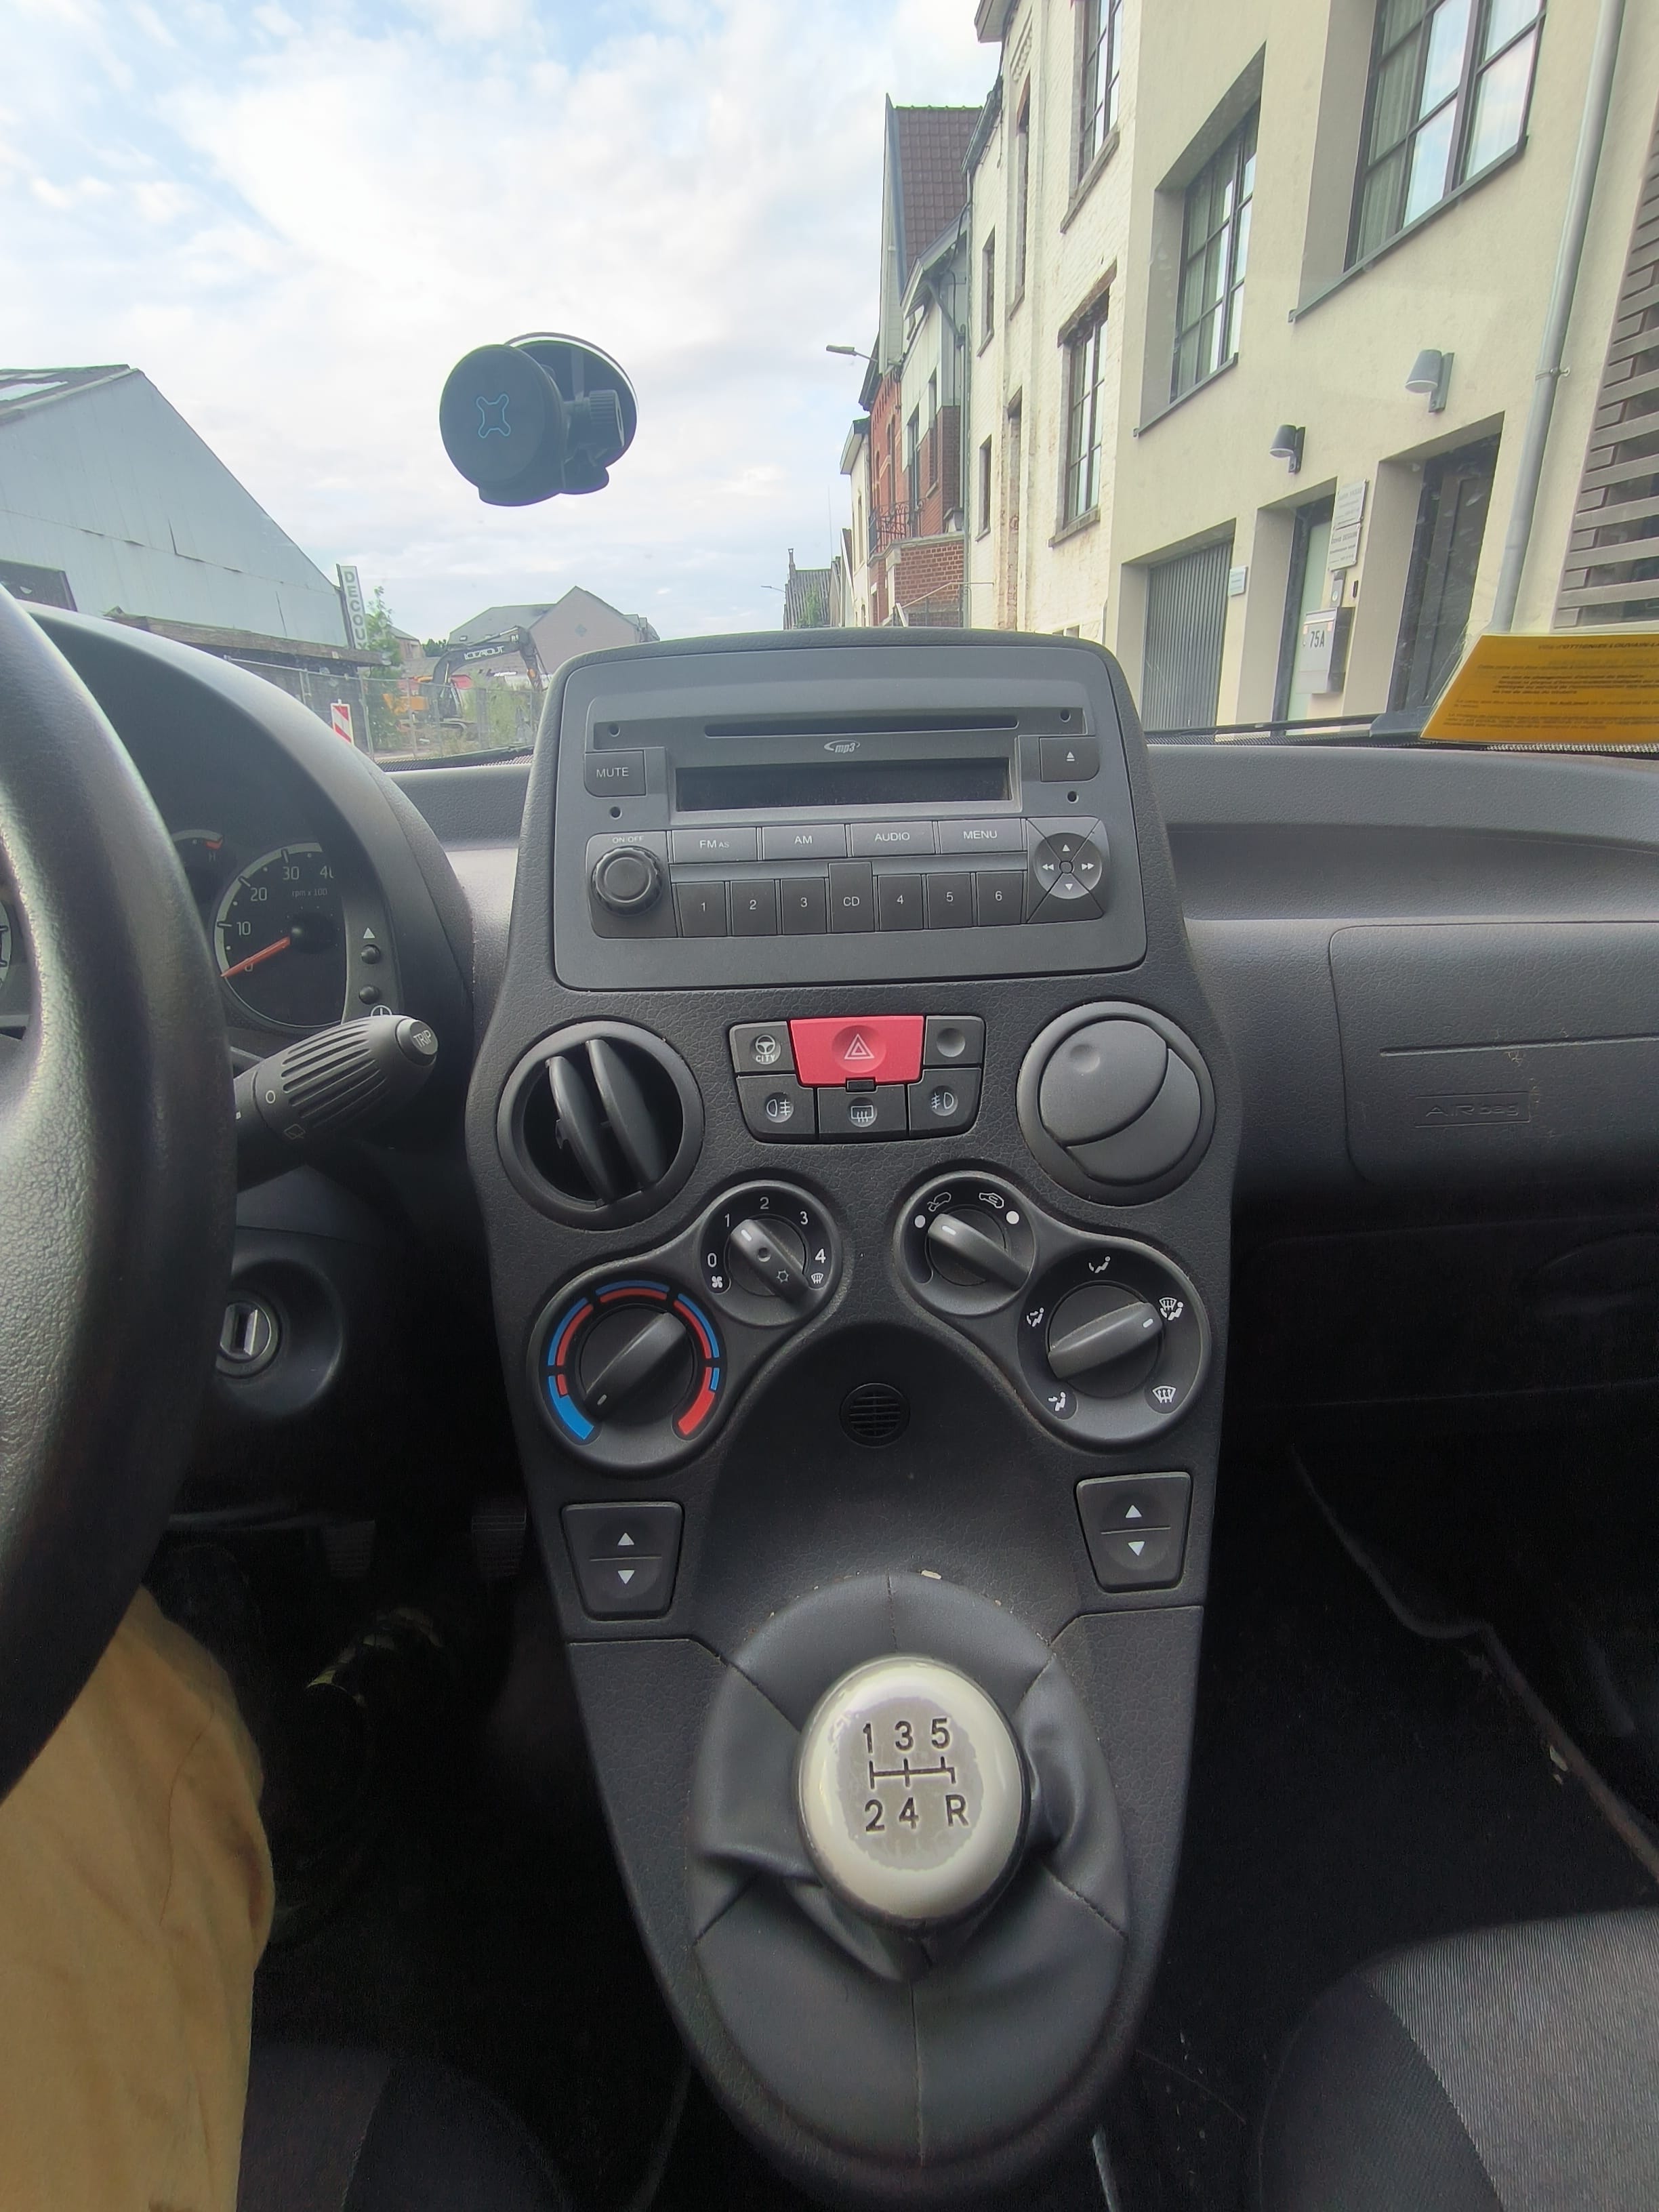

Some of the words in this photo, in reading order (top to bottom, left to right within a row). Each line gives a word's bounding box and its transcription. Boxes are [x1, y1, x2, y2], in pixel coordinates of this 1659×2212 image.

[1309, 630, 1325, 648] 75A
[834, 742, 856, 754] mp3
[596, 766, 630, 779] MUTE
[794, 835, 813, 844] AM
[874, 831, 911, 842] AUDIO
[963, 830, 998, 840] MENU
[699, 839, 717, 849] FM
[282, 865, 300, 880] 30
[250, 886, 268, 901] 20
[291, 889, 306, 898] rpm
[314, 887, 328, 896] 100
[945, 891, 954, 902] 5
[994, 890, 1003, 901] 6
[749, 899, 758, 910] 2
[800, 897, 808, 908] 3
[842, 896, 861, 907] CD
[896, 894, 904, 905] 4
[700, 901, 706, 912] 1
[236, 921, 251, 936] 10
[413, 1029, 432, 1048] TRIP
[755, 1054, 776, 1063] CITY
[759, 1196, 770, 1210] 2
[724, 1213, 731, 1227] 1
[800, 1210, 809, 1225] 3
[707, 1252, 717, 1268] 0
[815, 1248, 826, 1264] 4
[863, 1723, 872, 1753] 1
[895, 1721, 913, 1750] 3
[932, 1718, 949, 1748] 5
[865, 1800, 884, 1831] 2
[899, 1797, 918, 1828] 4
[946, 1795, 968, 1826] R
